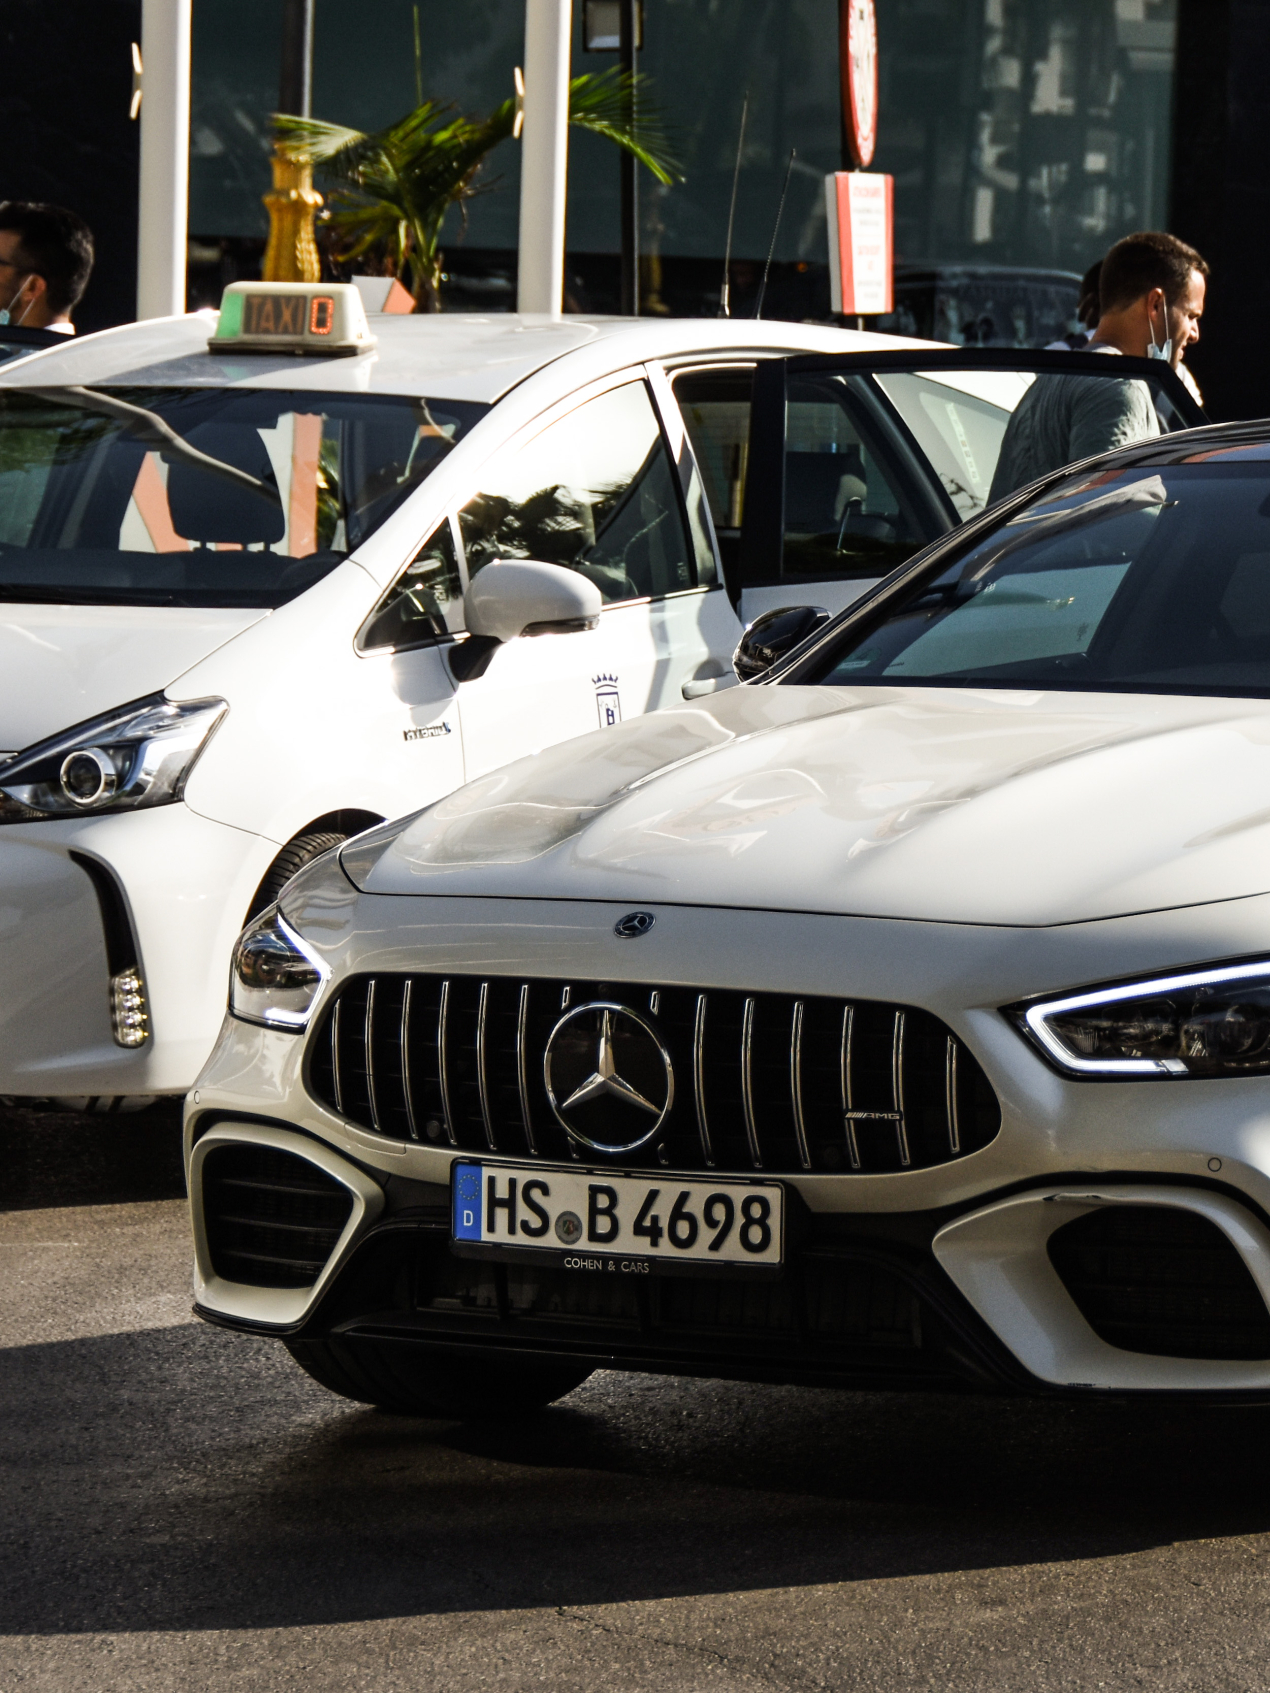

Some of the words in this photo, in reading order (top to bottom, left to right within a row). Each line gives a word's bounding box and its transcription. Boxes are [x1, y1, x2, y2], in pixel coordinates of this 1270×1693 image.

[250, 296, 306, 333] TAXI
[310, 296, 334, 335] 0
[463, 1210, 474, 1227] D
[486, 1174, 550, 1238] HS
[587, 1183, 620, 1243] B
[632, 1188, 772, 1253] 4698
[564, 1257, 603, 1270] COHEN
[607, 1260, 616, 1272] &
[620, 1262, 650, 1274] CARS
